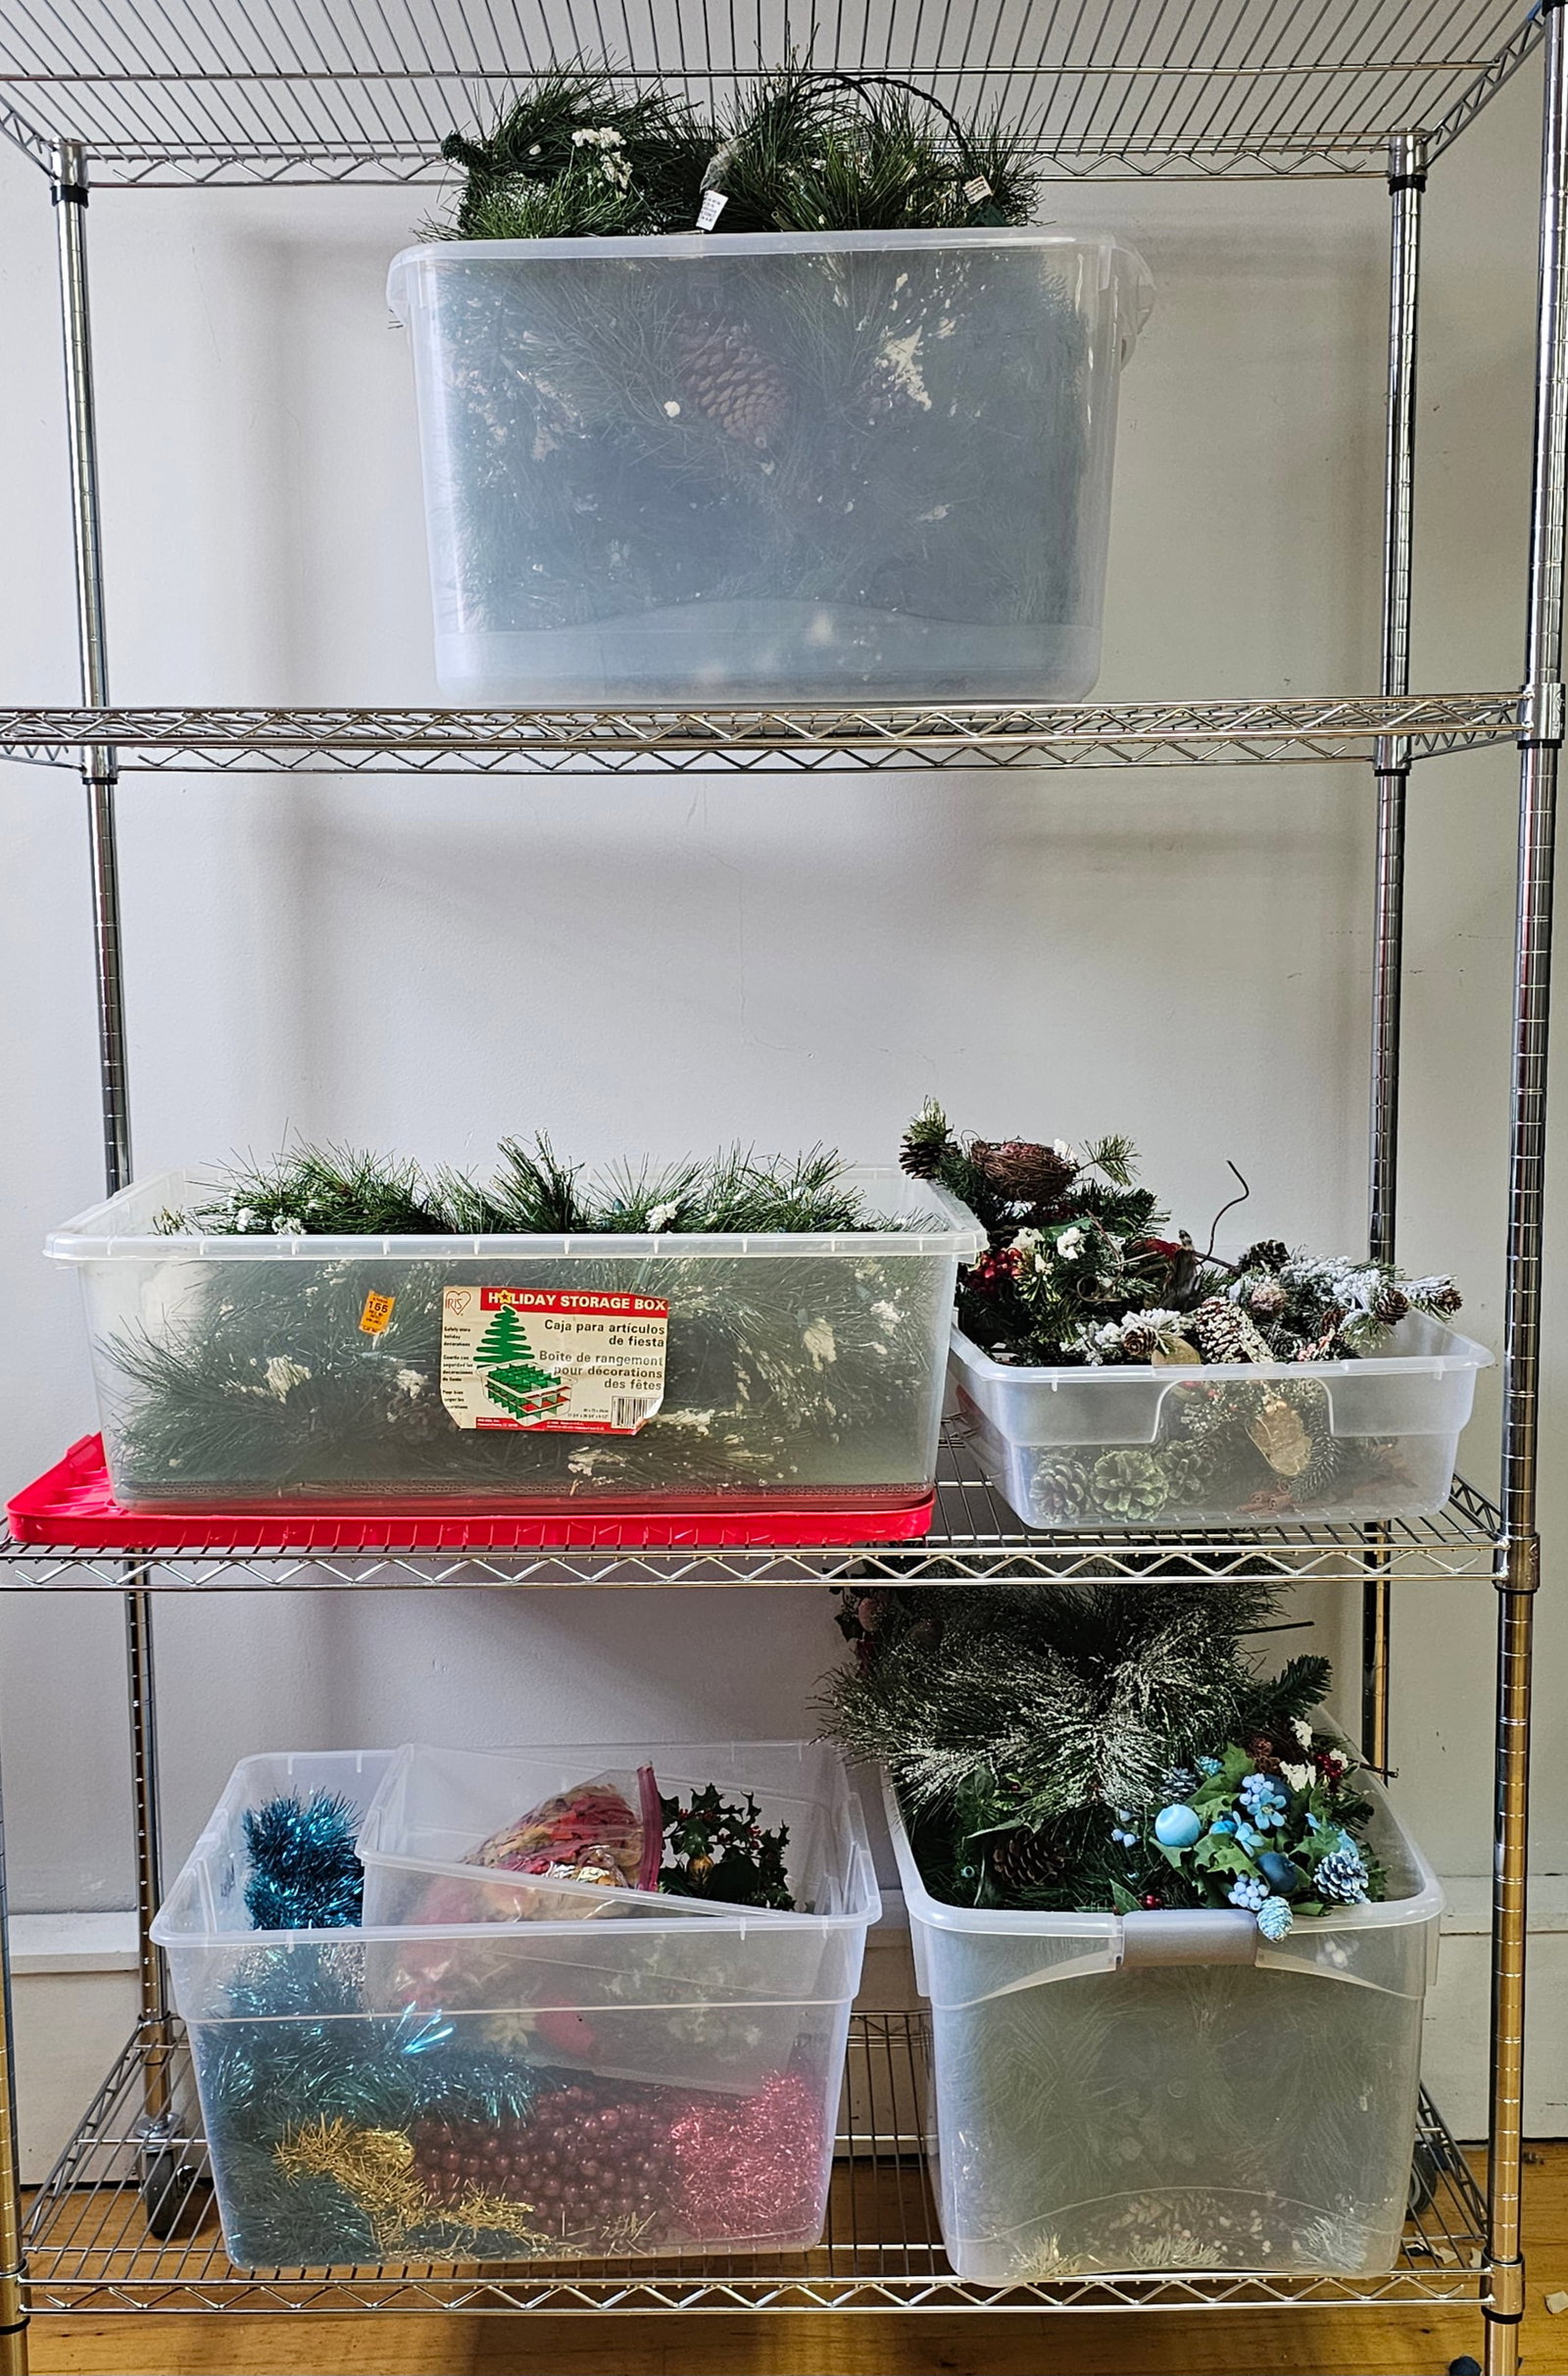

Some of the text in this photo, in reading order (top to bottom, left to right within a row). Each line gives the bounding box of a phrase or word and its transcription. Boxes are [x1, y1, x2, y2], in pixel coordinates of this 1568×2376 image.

[445, 1299, 463, 1310] IRIS
[488, 1290, 666, 1311] HOLIDAY STORAGE BOX
[544, 1319, 665, 1334] Caja para artículos
[609, 1335, 664, 1347] de fiesta
[539, 1350, 663, 1366] Boîte de rangement
[554, 1365, 662, 1378] pour décorations
[604, 1378, 662, 1391] des fêtes
